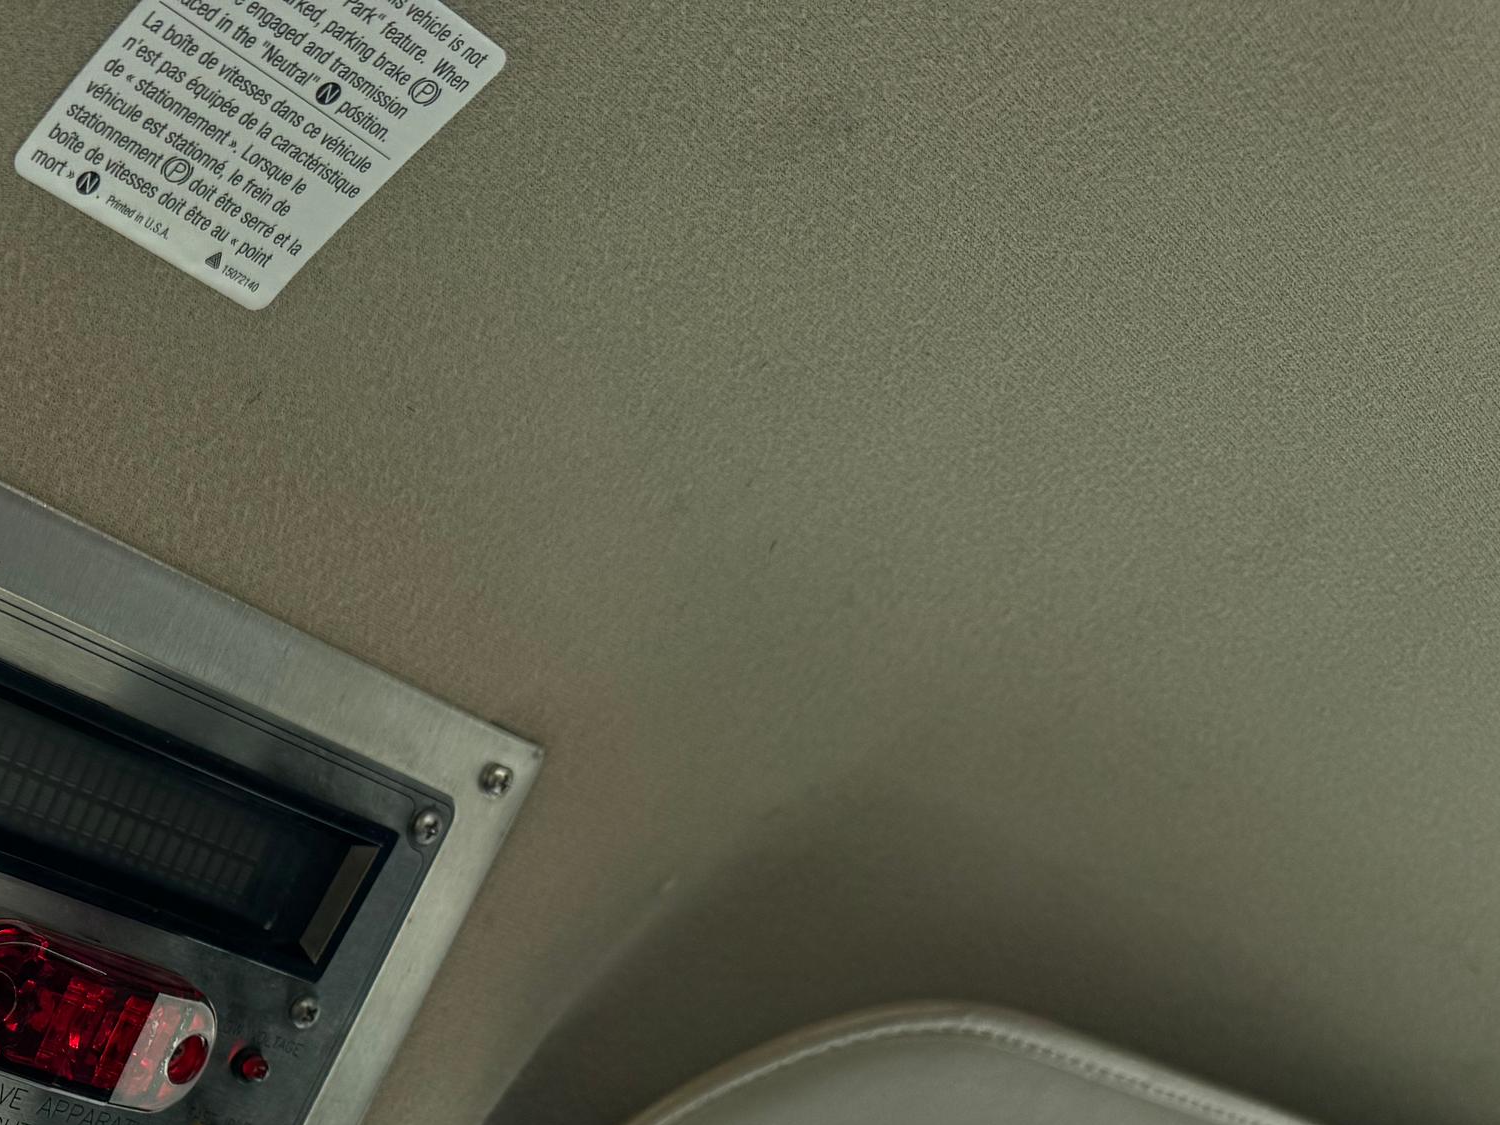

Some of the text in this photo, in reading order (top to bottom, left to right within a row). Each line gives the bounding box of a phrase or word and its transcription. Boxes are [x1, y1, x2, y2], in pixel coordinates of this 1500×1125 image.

[215, 13, 234, 33] in
[231, 24, 257, 49] the
[261, 40, 321, 87] "Neutral"
[246, 1, 408, 120] engaged and transmission
[323, 20, 375, 63] parking
[372, 51, 412, 86] brake
[380, 21, 428, 64] feature.
[432, 58, 471, 93] When
[406, 4, 452, 42] vehicle
[448, 34, 465, 51] is
[460, 48, 488, 69] not
[104, 57, 125, 78] de
[134, 78, 232, 148] stationnement
[240, 144, 293, 186] Lorsque
[290, 178, 307, 195] le
[122, 36, 361, 199] n'est pas équipée de la caractéristique
[142, 10, 372, 173] La boîte de vitesses dans ce véhicule
[30, 149, 69, 179] mort
[48, 123, 86, 154] boîte
[84, 146, 105, 166] de
[104, 158, 160, 199] vitesses
[158, 190, 188, 214] doit
[183, 205, 212, 231] être
[211, 224, 230, 243] au
[235, 243, 274, 269] point
[66, 103, 164, 169] stationnement
[189, 179, 218, 202] doit
[214, 193, 242, 217] être
[240, 210, 275, 239] serré
[273, 232, 292, 249] et
[286, 238, 303, 257] la
[85, 80, 291, 217] véhicule est stationné, le frein de
[105, 194, 170, 241] Printed in U.S.A.
[221, 265, 260, 293] 15072140
